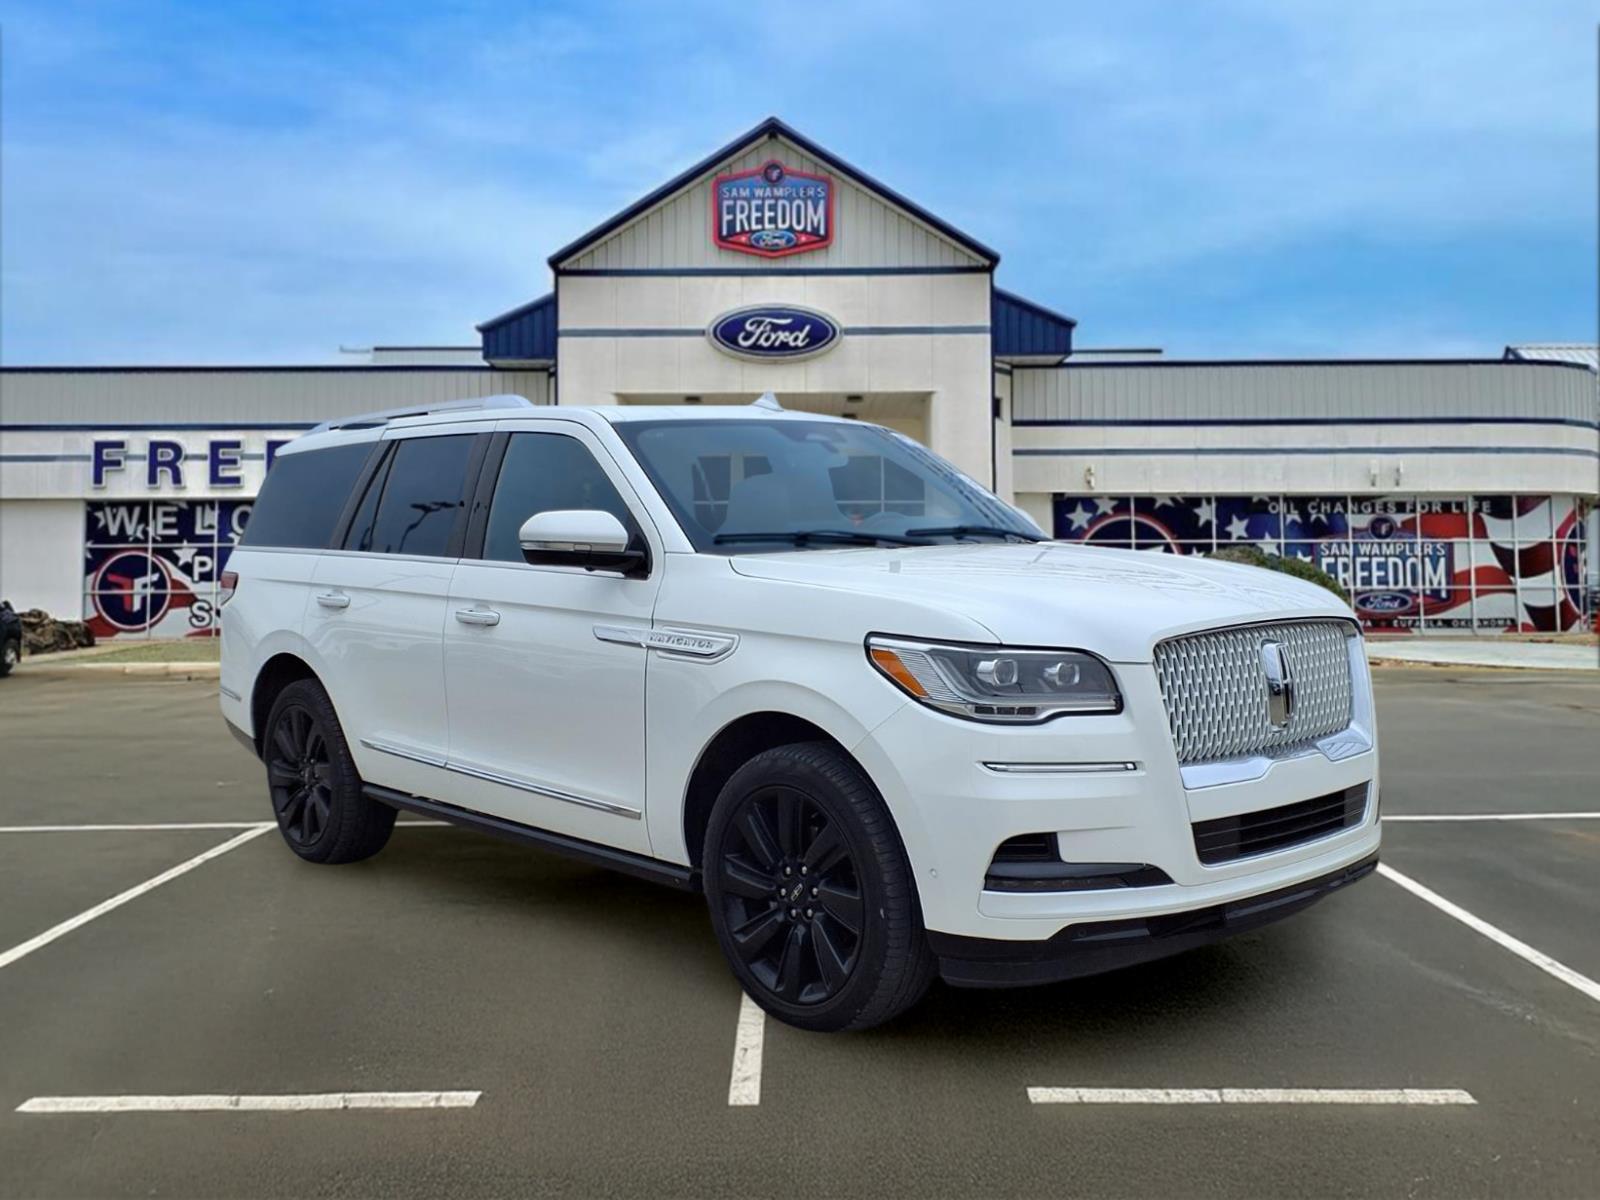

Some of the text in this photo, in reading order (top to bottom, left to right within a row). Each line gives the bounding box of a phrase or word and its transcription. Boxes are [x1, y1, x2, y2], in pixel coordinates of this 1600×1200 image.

[722, 187, 750, 199] SAM
[722, 199, 826, 236] FREEDOM
[737, 316, 811, 348] Ford
[1268, 501, 1492, 514] OIL CHANGES FOR LIFE
[1321, 556, 1447, 599] FREEDOM
[1365, 595, 1400, 609] Ford
